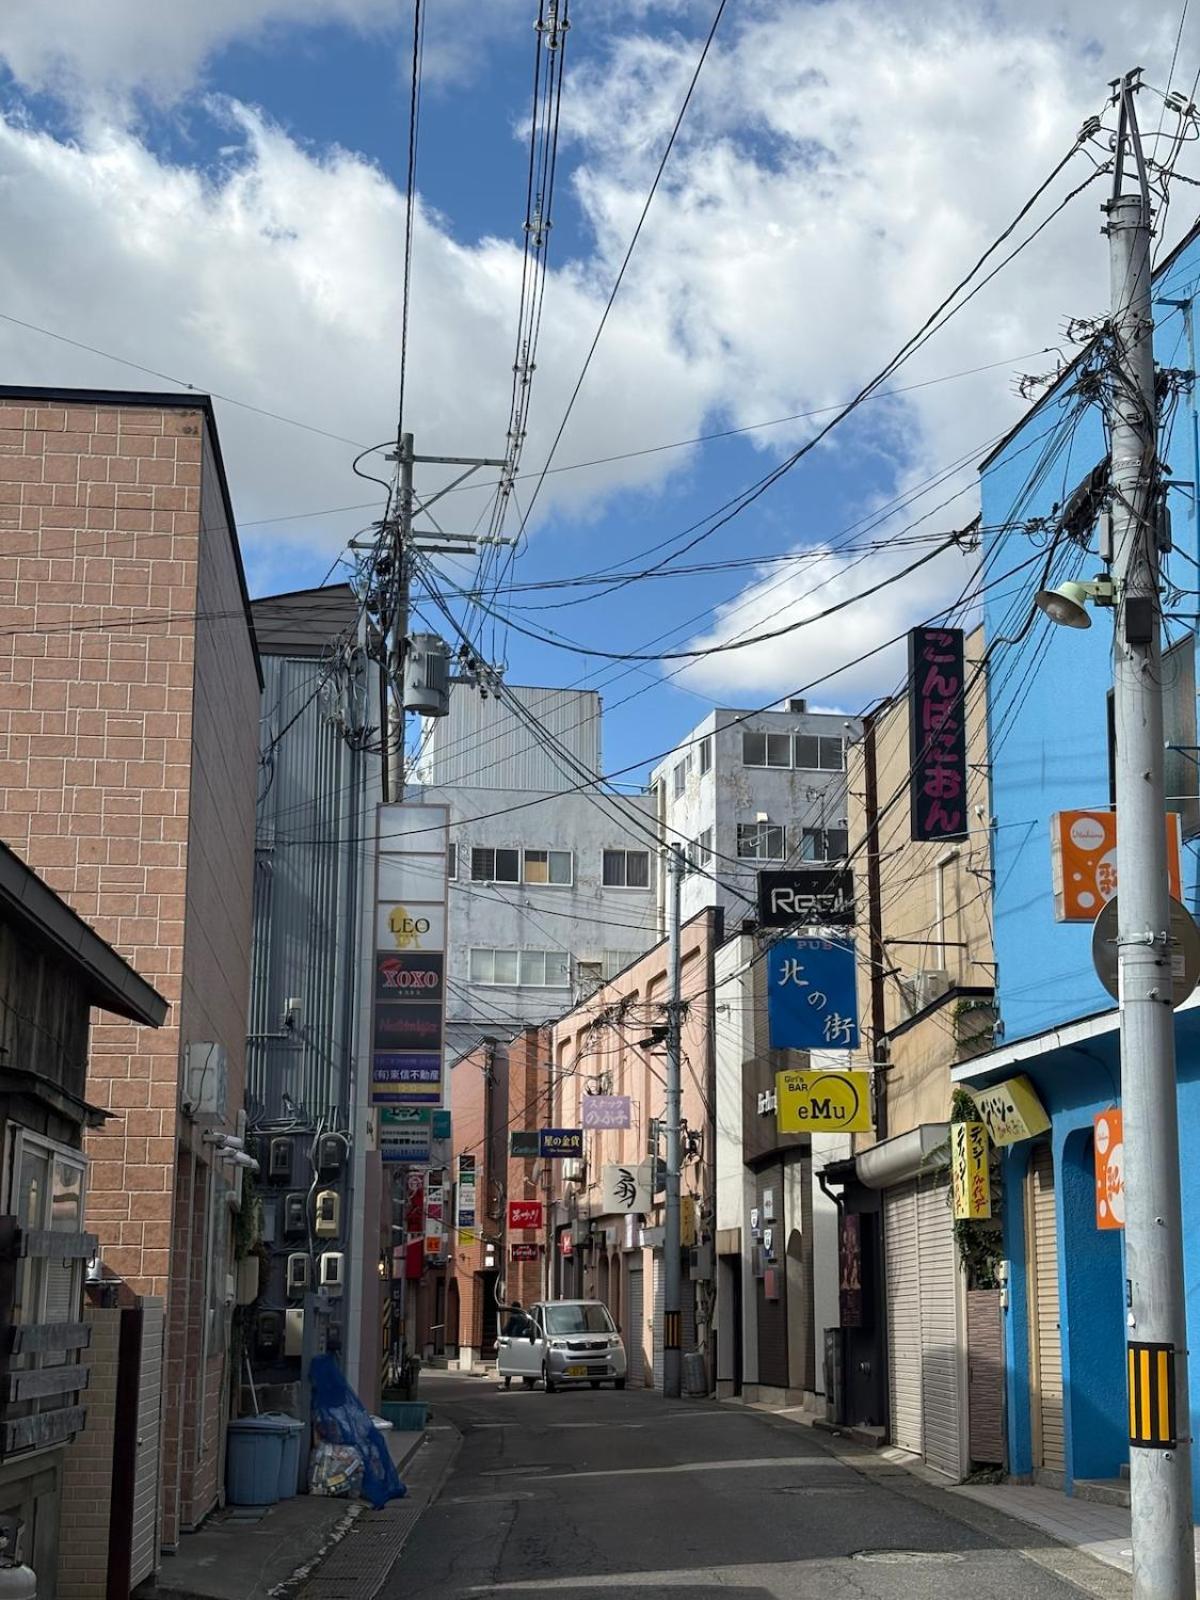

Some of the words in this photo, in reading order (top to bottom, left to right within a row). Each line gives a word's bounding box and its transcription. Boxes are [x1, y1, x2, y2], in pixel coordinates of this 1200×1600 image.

[390, 918, 430, 933] LEO
[797, 940, 833, 950] PUB
[382, 970, 439, 988] XOXO
[777, 957, 855, 1045] 北の街
[784, 1075, 804, 1083] Girl's
[788, 1084, 809, 1092] BAR
[798, 1098, 845, 1119] eMu
